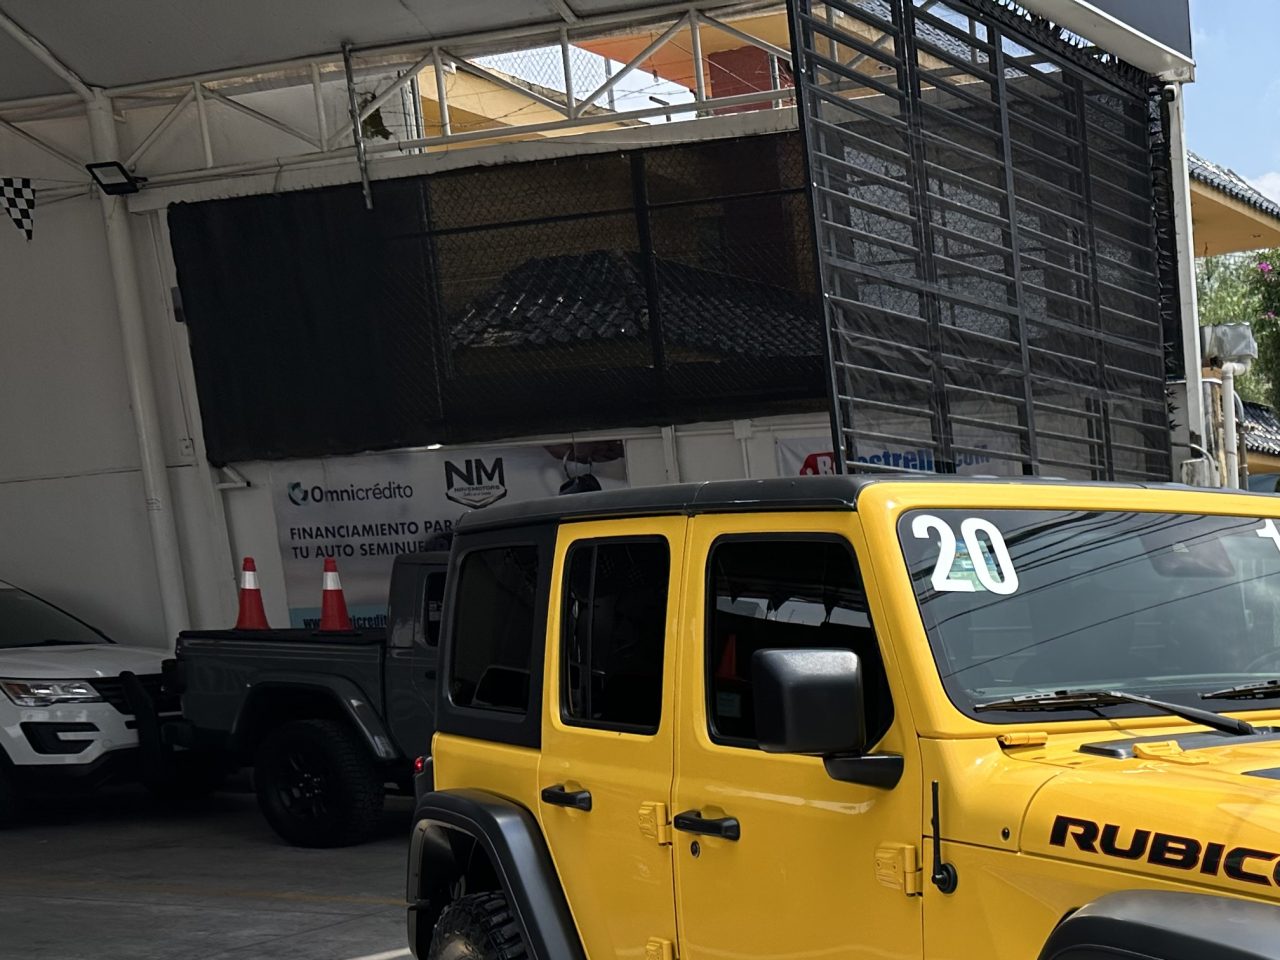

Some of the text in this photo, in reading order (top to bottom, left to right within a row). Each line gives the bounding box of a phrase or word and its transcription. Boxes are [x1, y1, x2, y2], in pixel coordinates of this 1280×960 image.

[445, 457, 505, 490] NM
[311, 482, 413, 503] Omnicrédito
[290, 518, 456, 540] FINANCIAMIENTO PAR
[291, 540, 425, 559] TU AUTO SEMINUE
[912, 514, 1020, 595] 20
